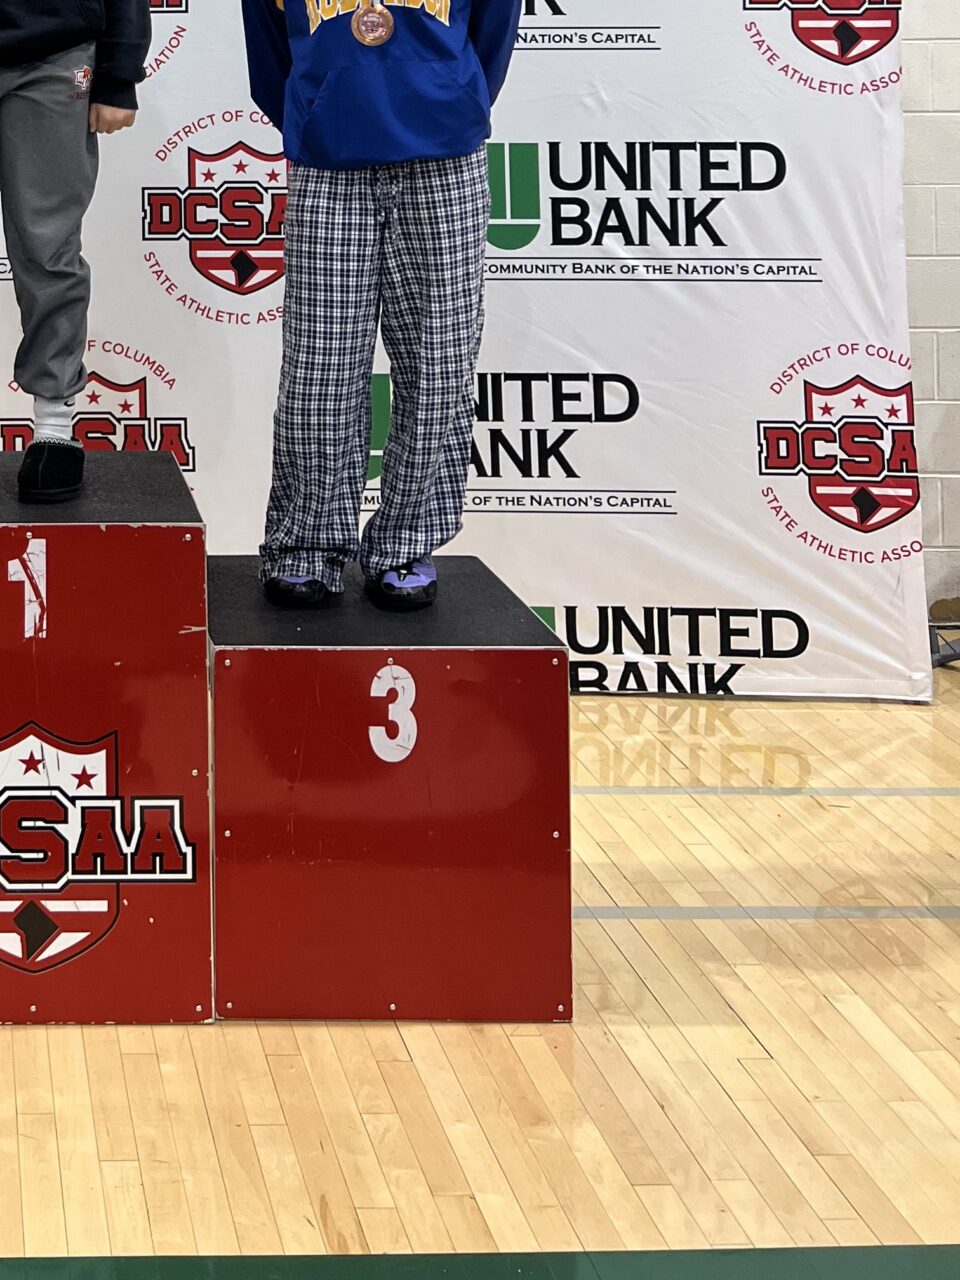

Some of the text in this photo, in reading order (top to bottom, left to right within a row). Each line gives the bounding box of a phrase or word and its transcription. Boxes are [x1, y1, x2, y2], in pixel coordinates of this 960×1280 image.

[592, 32, 655, 44] CAPITAL
[745, 21, 779, 65] STATE
[778, 64, 853, 96] ATHLETIC
[547, 141, 786, 191] UNITED
[549, 197, 727, 246] BANK
[144, 252, 247, 325] STATE ATHLETIC
[573, 263, 817, 276] BANK OF THE NATION'S CAPITAL
[770, 344, 858, 396] DISTRICT OF
[473, 372, 640, 423] NITED
[757, 416, 919, 482] DCSA
[472, 495, 672, 507] OF THE NATION'S CAPITAL
[761, 487, 796, 531] STATE
[797, 531, 874, 564] ATHLETIC
[7, 538, 48, 639] 1
[564, 606, 810, 659] UNITED
[368, 664, 418, 763] 3
